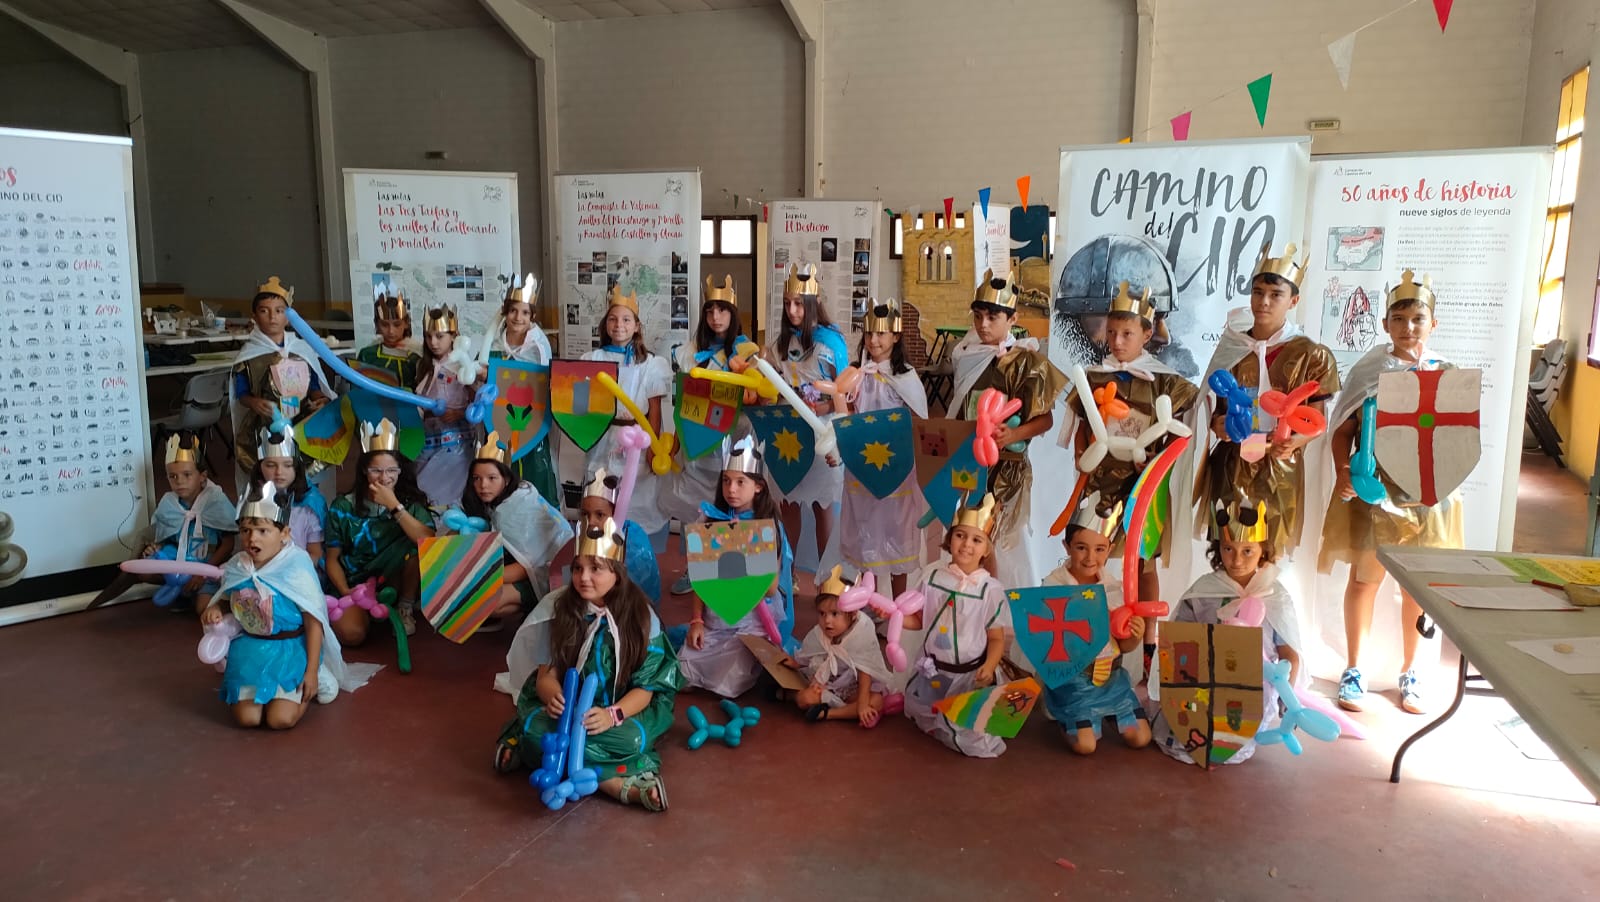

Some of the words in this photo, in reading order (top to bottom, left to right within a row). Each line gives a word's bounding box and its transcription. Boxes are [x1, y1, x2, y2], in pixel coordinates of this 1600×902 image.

[377, 191, 391, 201] Las
[391, 192, 411, 202] rutas
[577, 189, 588, 200] Las
[1090, 166, 1268, 220] CAMINO
[1341, 184, 1361, 202] 50
[1366, 183, 1409, 203] años
[1414, 178, 1438, 201] de
[1440, 179, 1517, 203] historia
[22, 192, 43, 203] DEL
[45, 193, 63, 204] CID
[378, 204, 395, 217] Las
[398, 204, 416, 217] Tres
[419, 204, 450, 220] Taifas
[452, 208, 460, 221] y
[587, 201, 618, 215] Conquista
[1430, 207, 1458, 217] siglos
[1460, 207, 1472, 216] de
[1474, 207, 1511, 218] leyenda
[379, 220, 393, 233] los
[395, 219, 428, 234] anillos
[431, 222, 440, 233] de
[444, 221, 498, 235] Gallocanta
[785, 220, 794, 233] El
[1144, 211, 1174, 239] del
[380, 241, 388, 253] y
